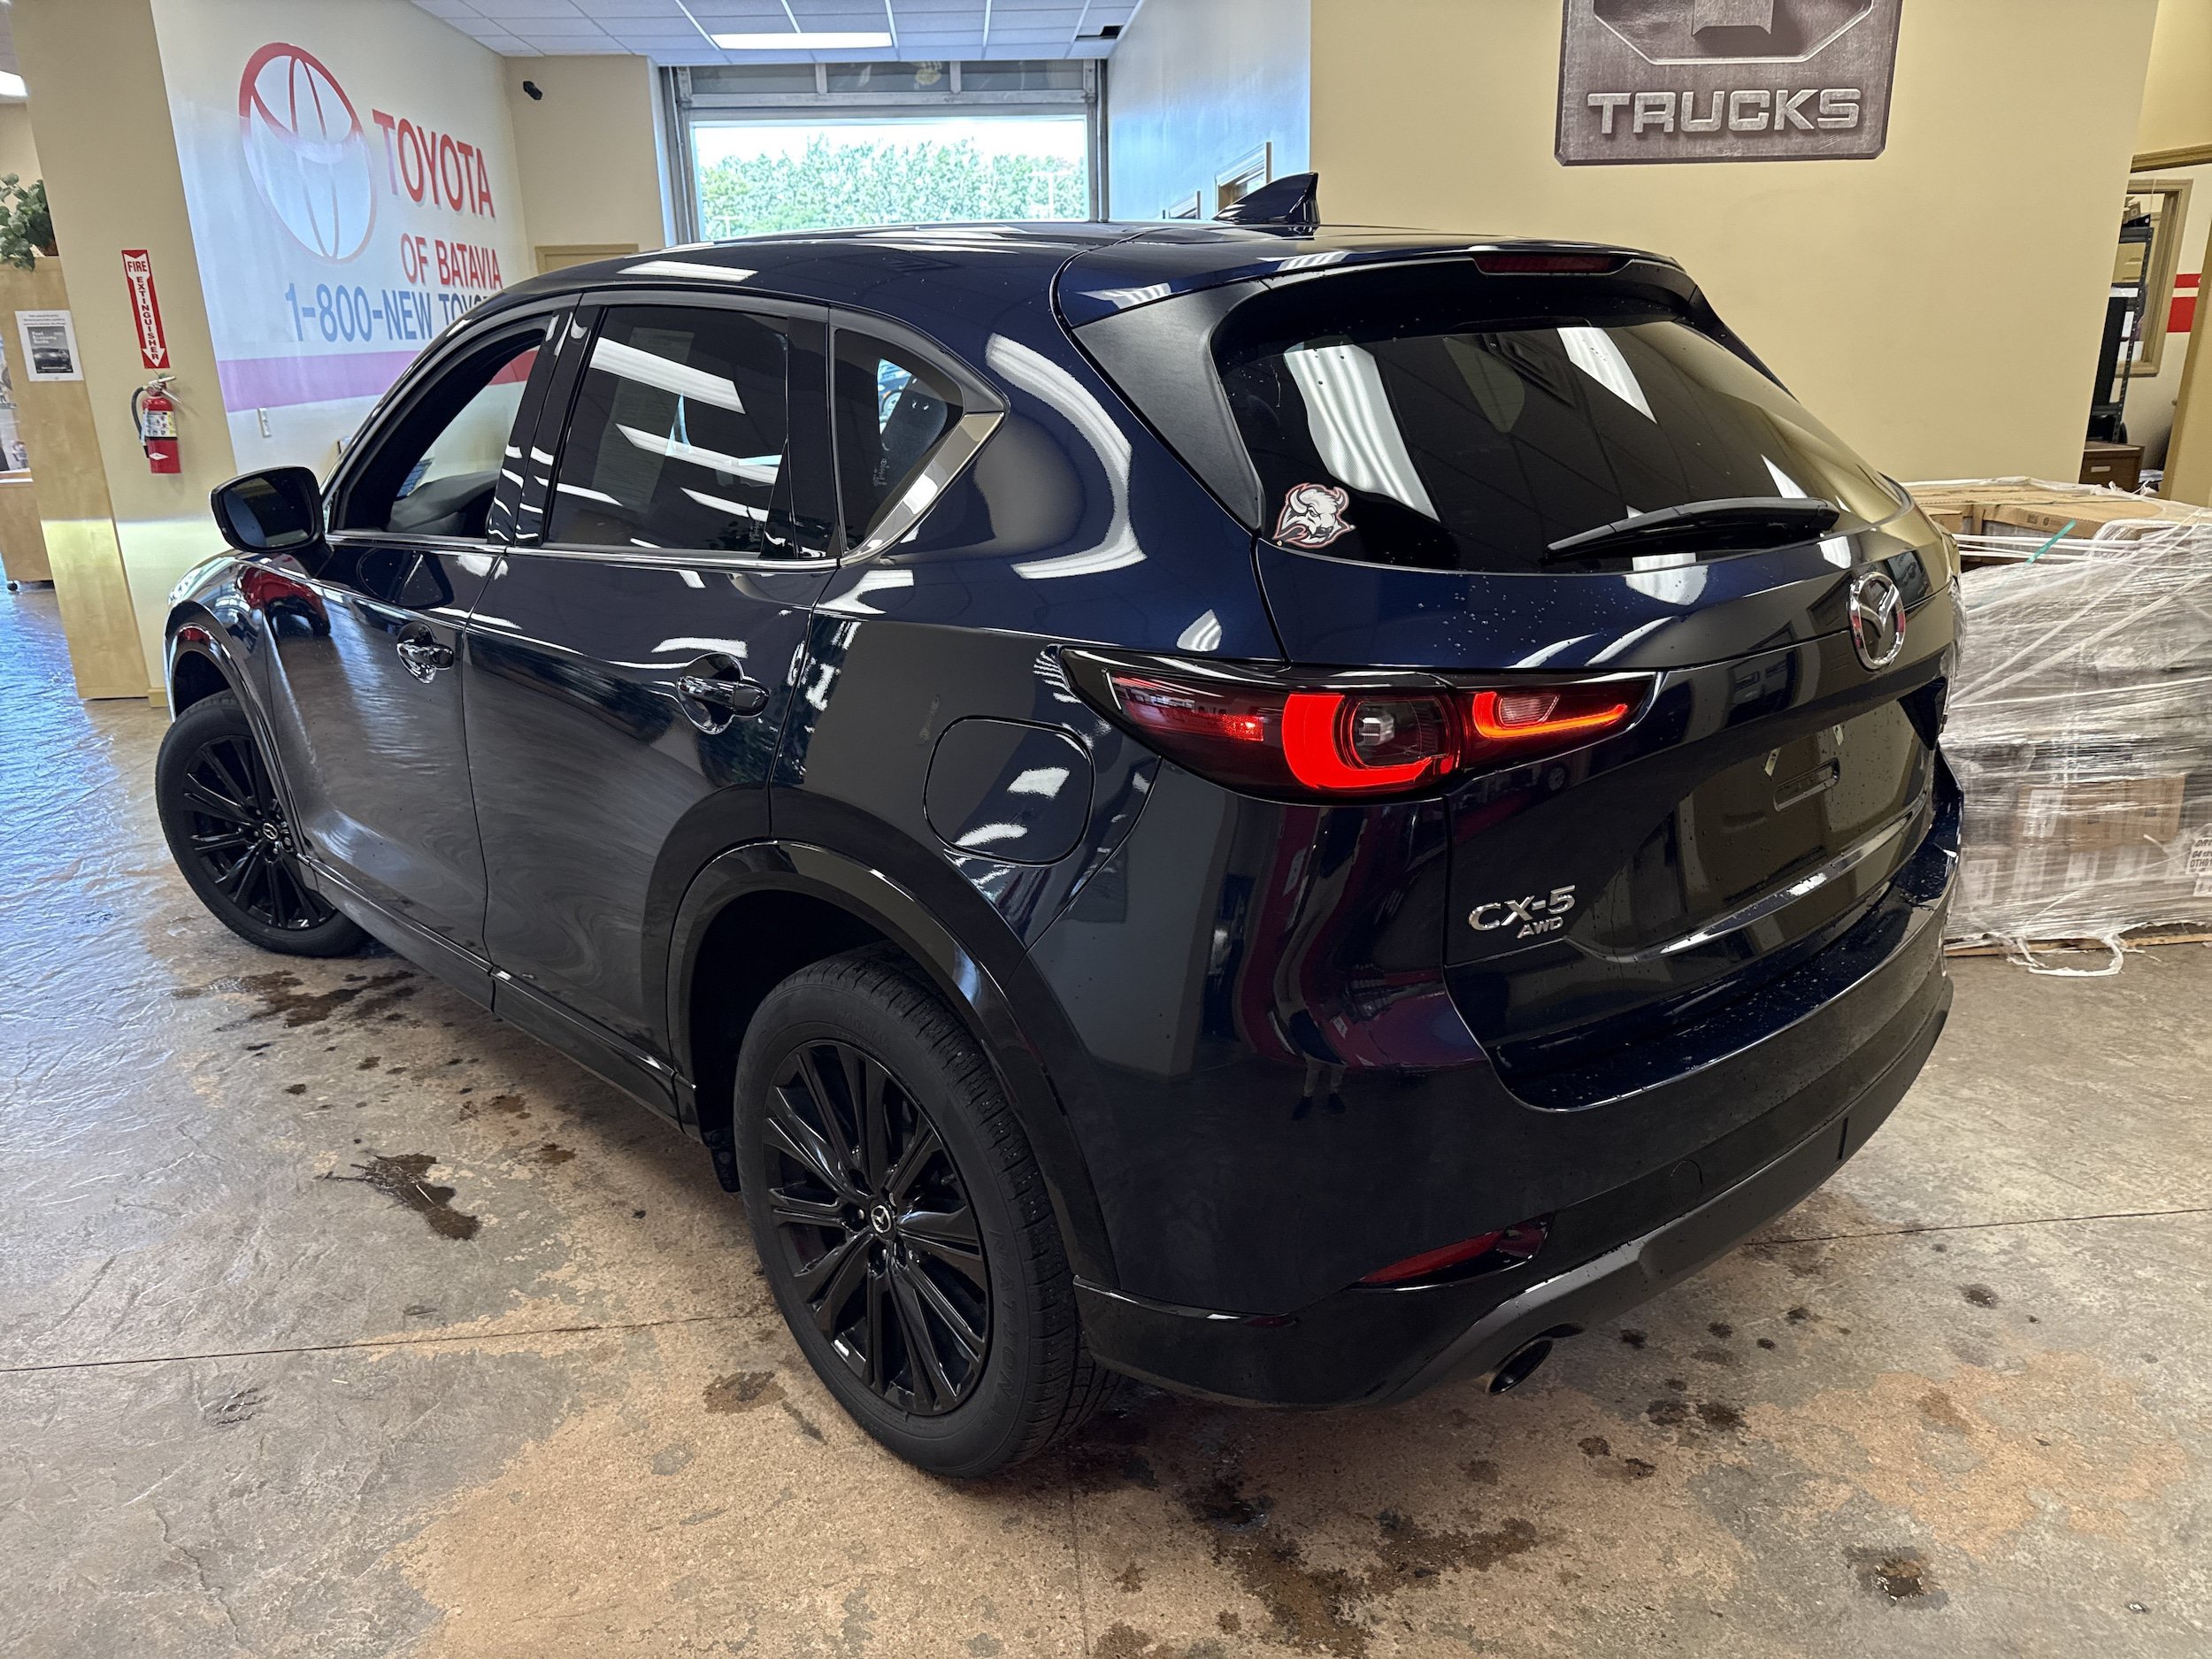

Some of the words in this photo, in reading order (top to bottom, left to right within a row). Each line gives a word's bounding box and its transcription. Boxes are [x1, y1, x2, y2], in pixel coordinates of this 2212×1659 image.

[1587, 88, 1861, 134] TRUCKS
[373, 108, 495, 219] TOYOTA
[127, 261, 148, 272] FIRE
[401, 233, 427, 284] OF
[435, 239, 503, 289] BATAVIA
[136, 276, 160, 360] EXTINGUISHER
[285, 282, 434, 342] 1-800-NEW
[1469, 885, 1576, 931] CX-5
[1516, 916, 1564, 939] AWD
